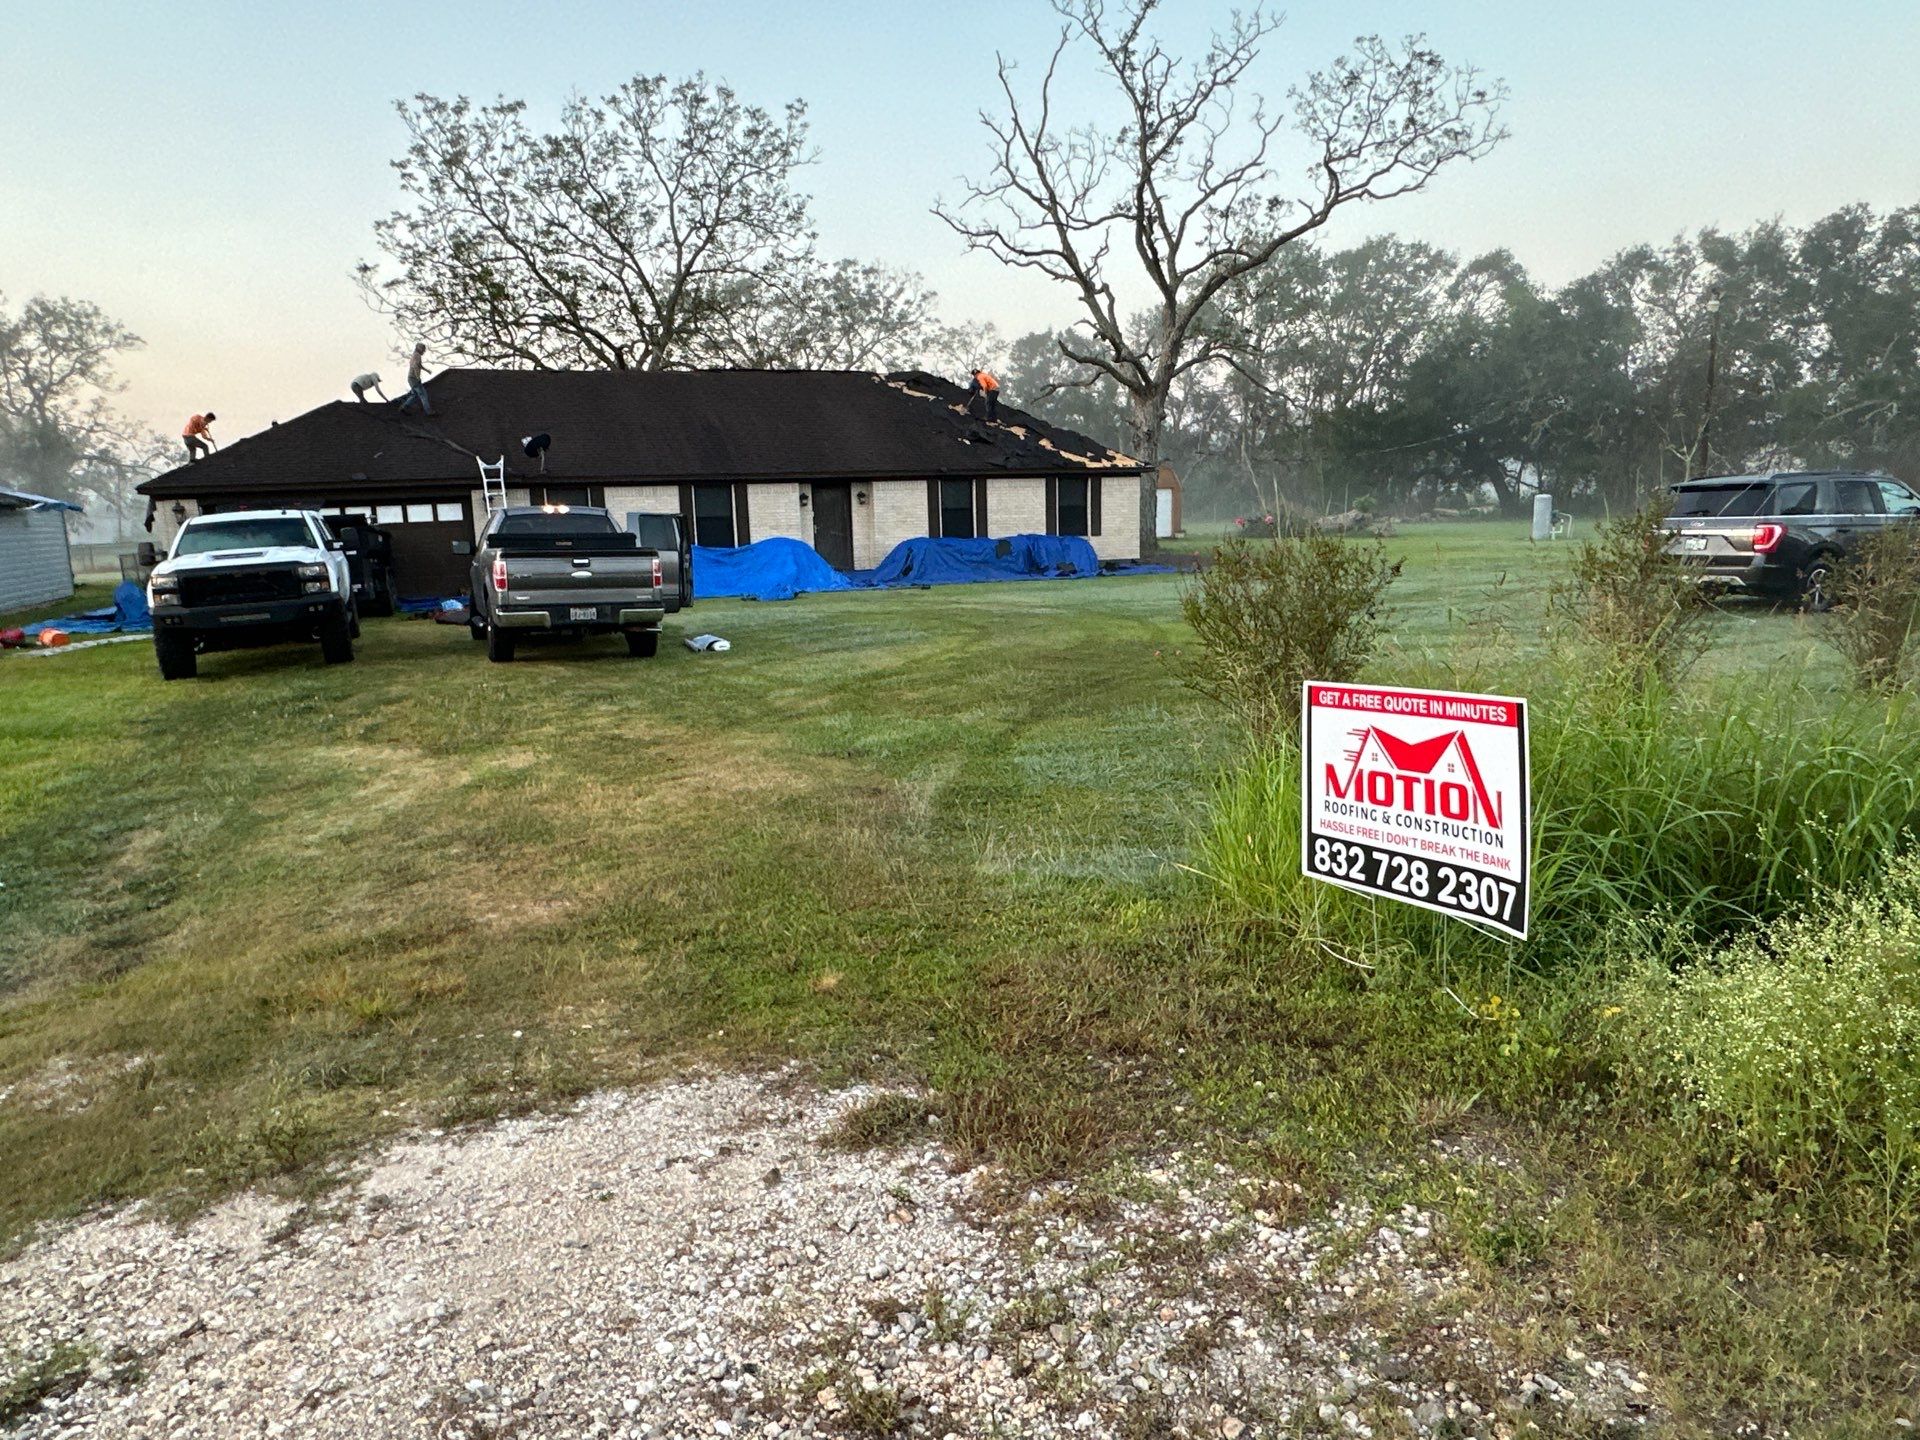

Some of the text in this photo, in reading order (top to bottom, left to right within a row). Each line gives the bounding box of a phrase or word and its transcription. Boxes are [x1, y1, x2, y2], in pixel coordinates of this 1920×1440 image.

[1319, 691, 1507, 722] GET A FREE QUOTE IN MINUTES
[1325, 763, 1503, 829] MOTION
[1320, 818, 1354, 836] HASSLE
[1357, 826, 1379, 840] FREE
[1387, 833, 1417, 848] DON'T
[1421, 840, 1456, 856] BREAK
[1459, 847, 1480, 862] THE
[1483, 852, 1512, 871] BANK
[1325, 800, 1503, 848] ROOFING & CONSTRUCTION
[1314, 839, 1516, 921] 832 728 2307
